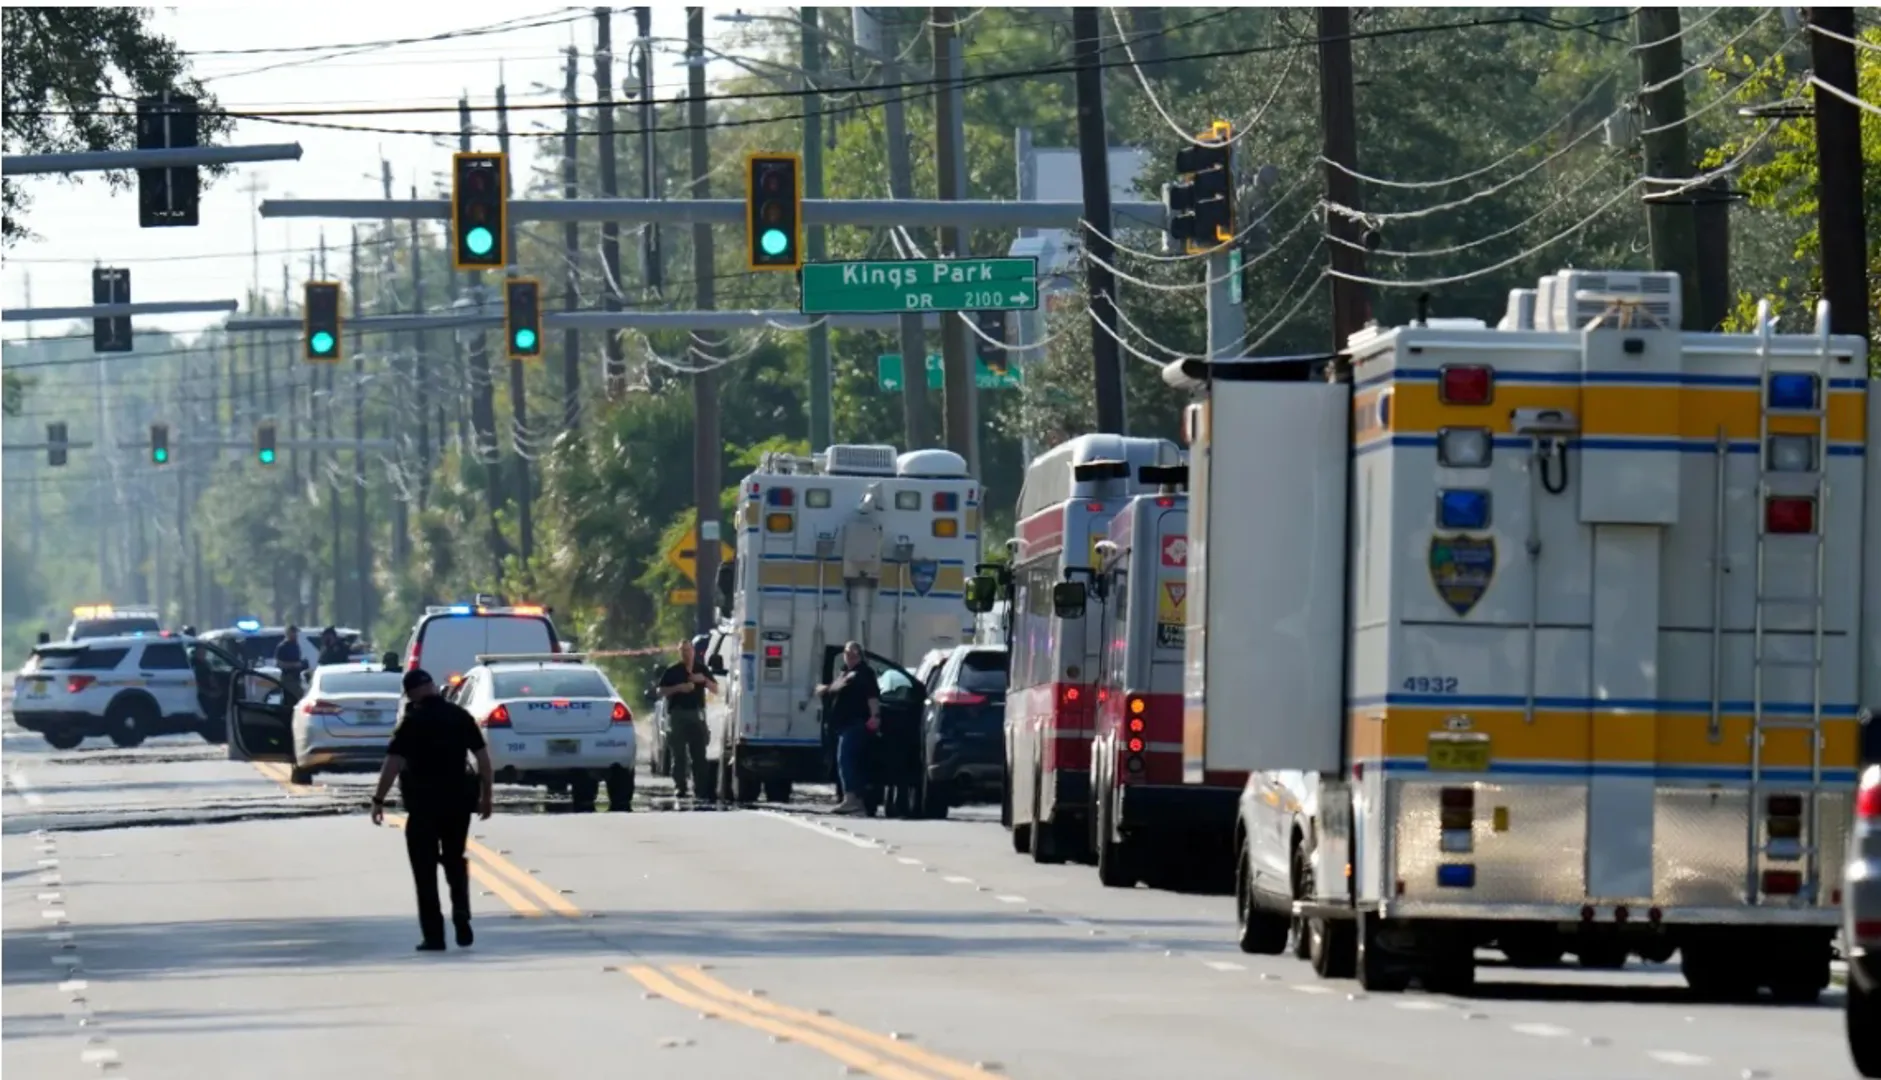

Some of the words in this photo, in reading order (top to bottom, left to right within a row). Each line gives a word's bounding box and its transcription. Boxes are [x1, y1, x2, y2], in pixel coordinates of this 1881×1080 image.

[843, 264, 917, 288] Kings
[933, 263, 992, 283] Park
[906, 293, 933, 308] DR
[965, 291, 1003, 307] 2100
[1403, 676, 1459, 692] 4932
[527, 701, 592, 711] POLICE
